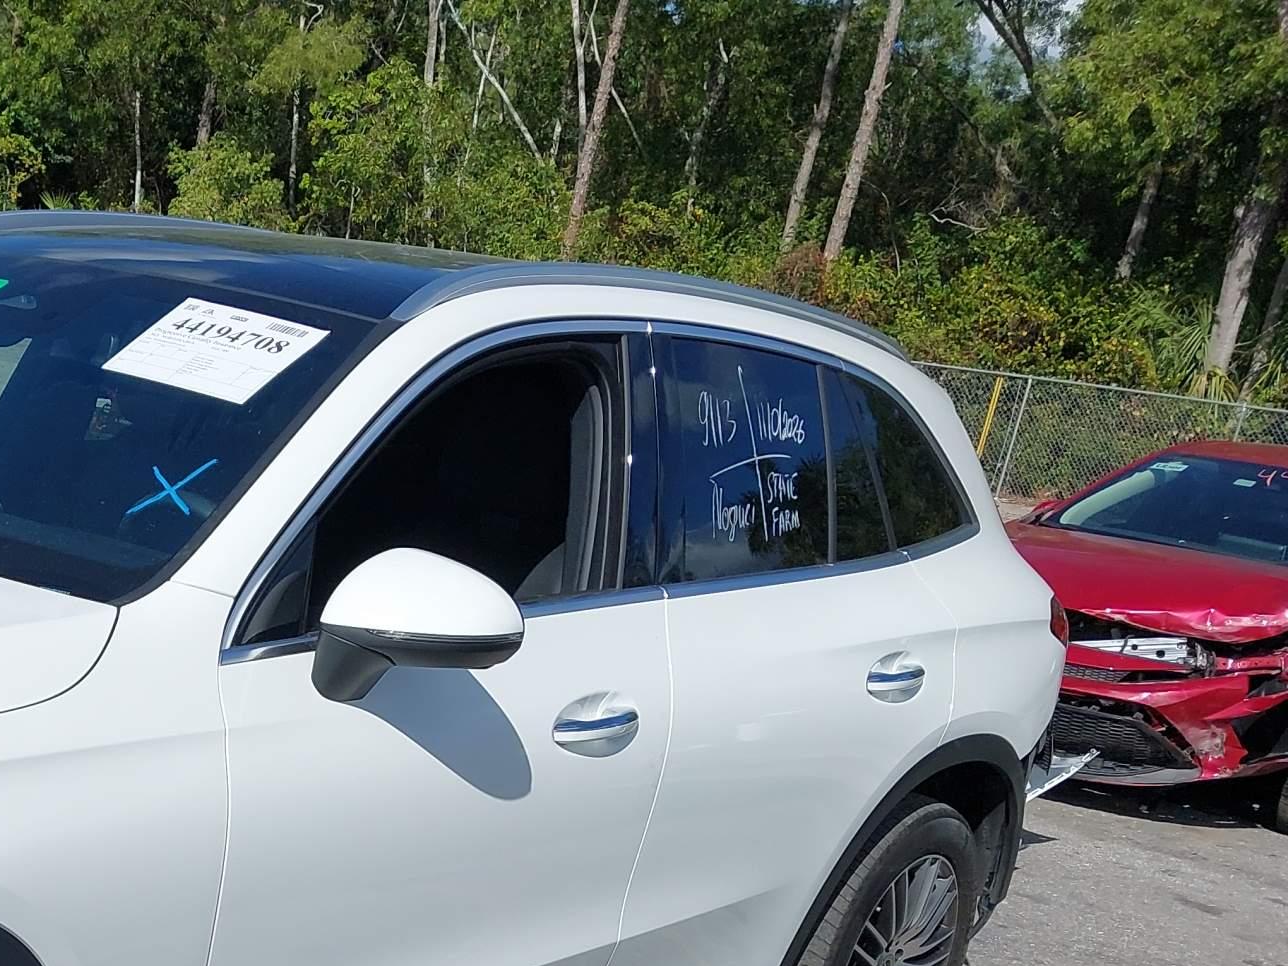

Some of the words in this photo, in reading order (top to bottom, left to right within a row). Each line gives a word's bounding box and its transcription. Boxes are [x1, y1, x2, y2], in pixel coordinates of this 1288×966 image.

[172, 317, 290, 354] 44194708
[767, 472, 799, 504] STATE
[772, 506, 801, 537] FARM
